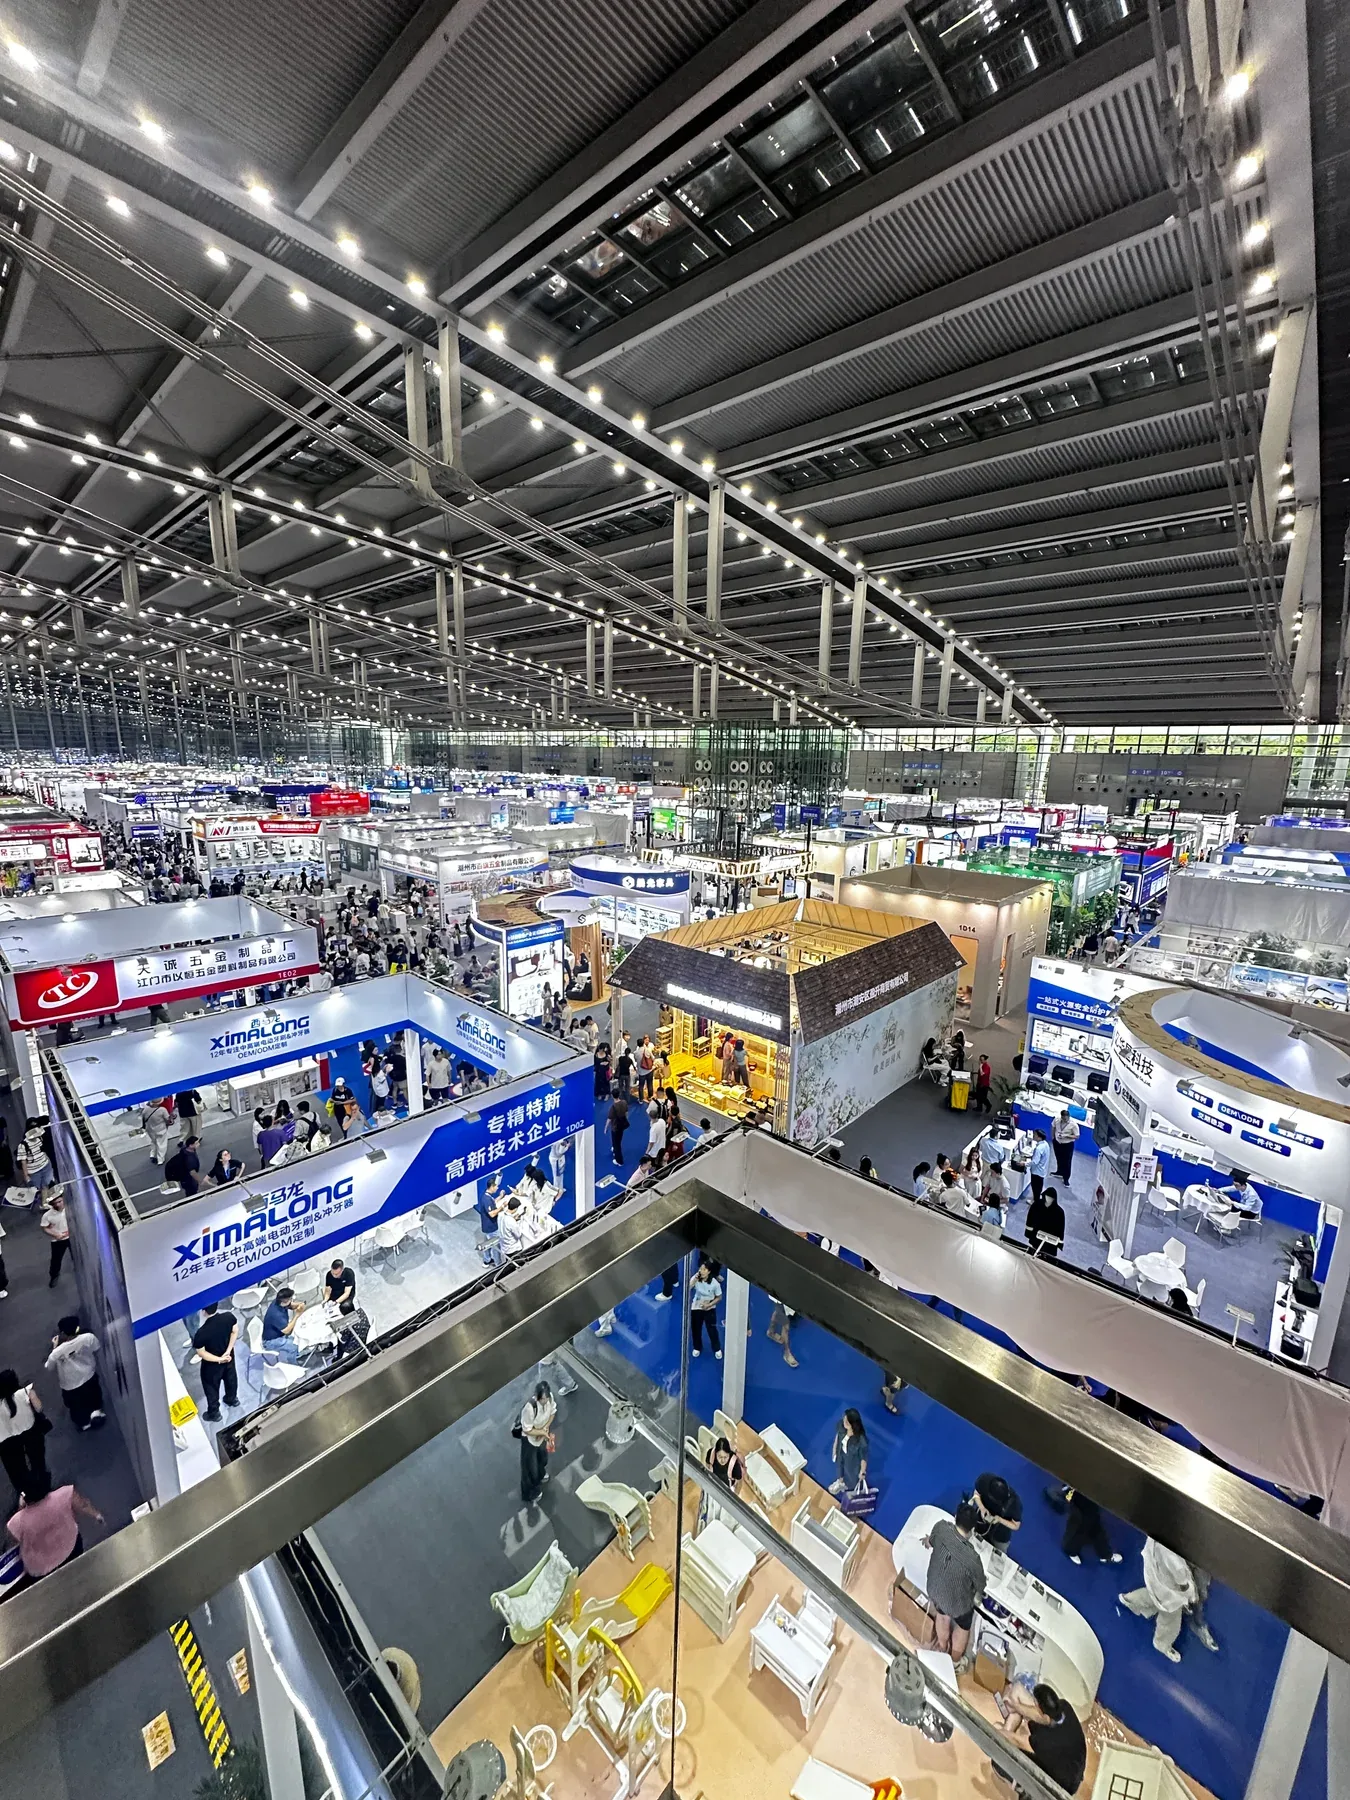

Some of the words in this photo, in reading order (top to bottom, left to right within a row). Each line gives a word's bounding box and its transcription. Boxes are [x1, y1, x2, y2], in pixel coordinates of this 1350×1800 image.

[959, 925, 976, 933] 1D14
[278, 969, 297, 979] 1E02
[1235, 974, 1263, 983] CLEANER
[47, 974, 85, 1000] TC
[486, 1089, 561, 1134] 专精特新
[1220, 1104, 1260, 1127] OEM\ODM
[565, 1119, 585, 1134] 1D02
[445, 1114, 561, 1183] 高新技术企业
[1249, 1135, 1282, 1153] 一件代发
[172, 1197, 354, 1283] 12年专注中高端电动牙刷&冲牙器
[226, 1225, 315, 1273] OEM/ODM定制
